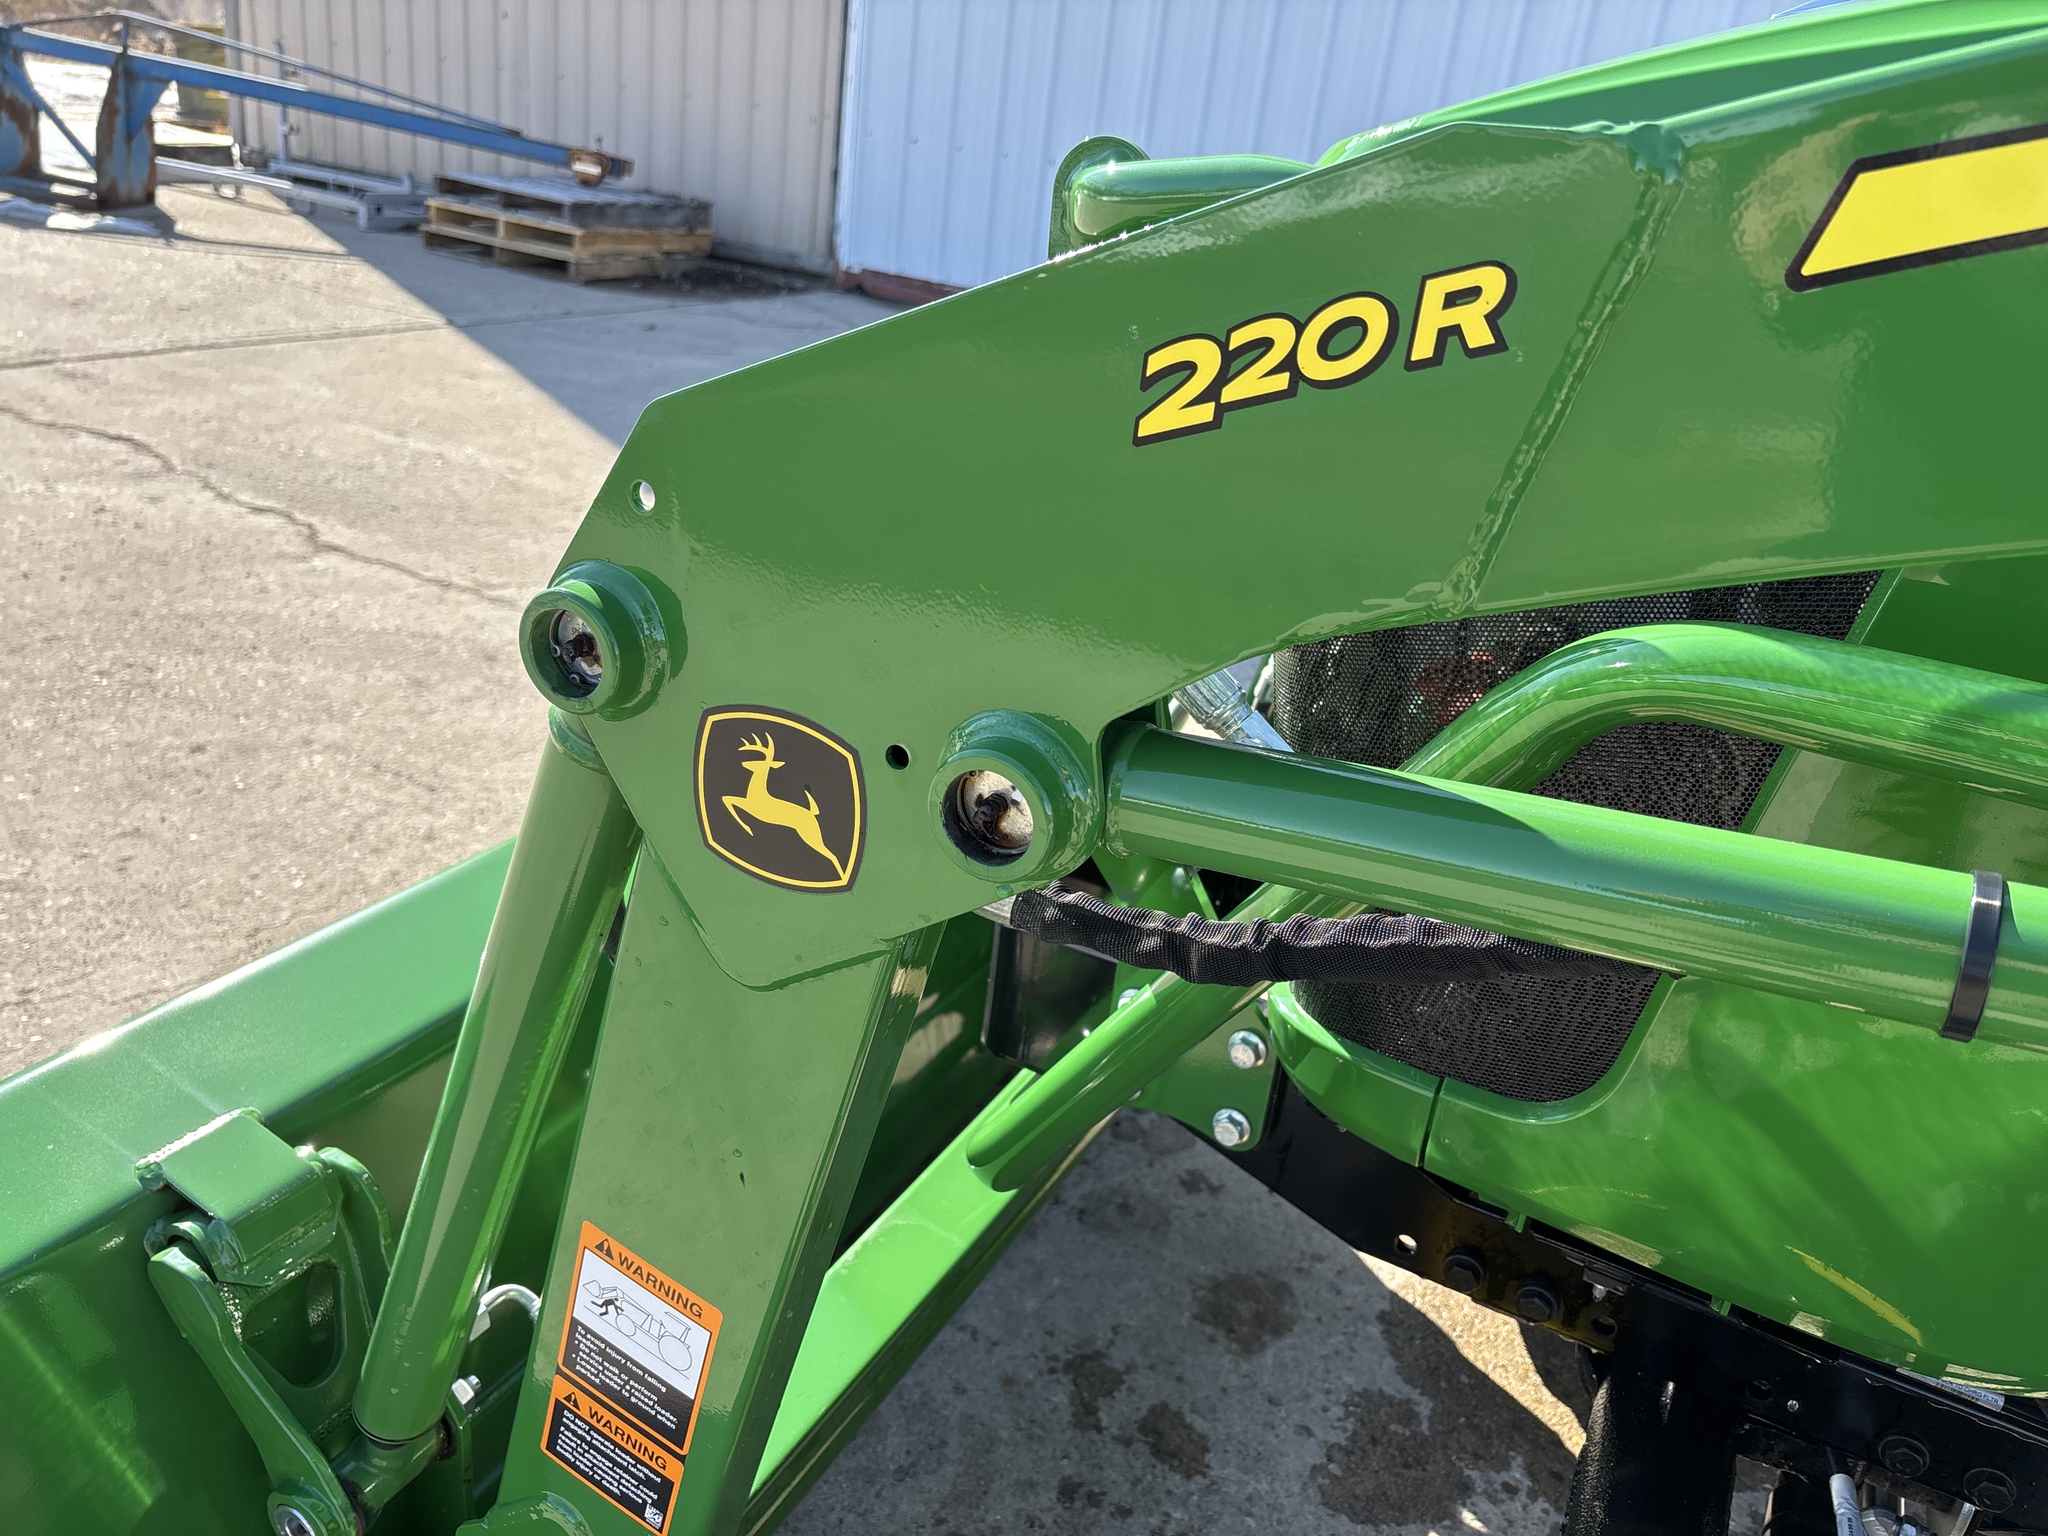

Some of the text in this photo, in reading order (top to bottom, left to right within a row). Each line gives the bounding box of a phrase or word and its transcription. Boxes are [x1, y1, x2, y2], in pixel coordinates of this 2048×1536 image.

[1133, 260, 1518, 447] 220 R
[619, 1252, 702, 1318] WARNING
[575, 1365, 601, 1385] parked.
[576, 1333, 599, 1352] loader:
[577, 1325, 666, 1392] To avoid injury from falling
[580, 1343, 589, 1353] Do
[590, 1352, 602, 1362] not
[603, 1361, 619, 1374] walk
[629, 1380, 657, 1401] perform
[576, 1357, 675, 1429] Lower loader to ground when
[578, 1352, 603, 1370] service
[605, 1372, 624, 1385] under
[630, 1389, 653, 1406] raised
[653, 1404, 677, 1423] loader.
[1983, 1393, 2000, 1405] FLTR
[556, 1445, 575, 1462] bodily
[575, 1460, 593, 1475] injury
[601, 1480, 621, 1496] death.
[558, 1434, 576, 1448] result
[583, 1453, 619, 1480] attachment
[619, 1479, 652, 1503] detaching
[559, 1426, 581, 1444] Failure
[589, 1449, 613, 1467] engage
[613, 1467, 638, 1485] retainer
[638, 1485, 657, 1499] could
[562, 1418, 646, 1480] engaging attachment latch.
[563, 1410, 661, 1483] DO NOT operate loader without
[589, 1406, 666, 1470] WARNING
[557, 1439, 642, 1503] from loader causing serious
